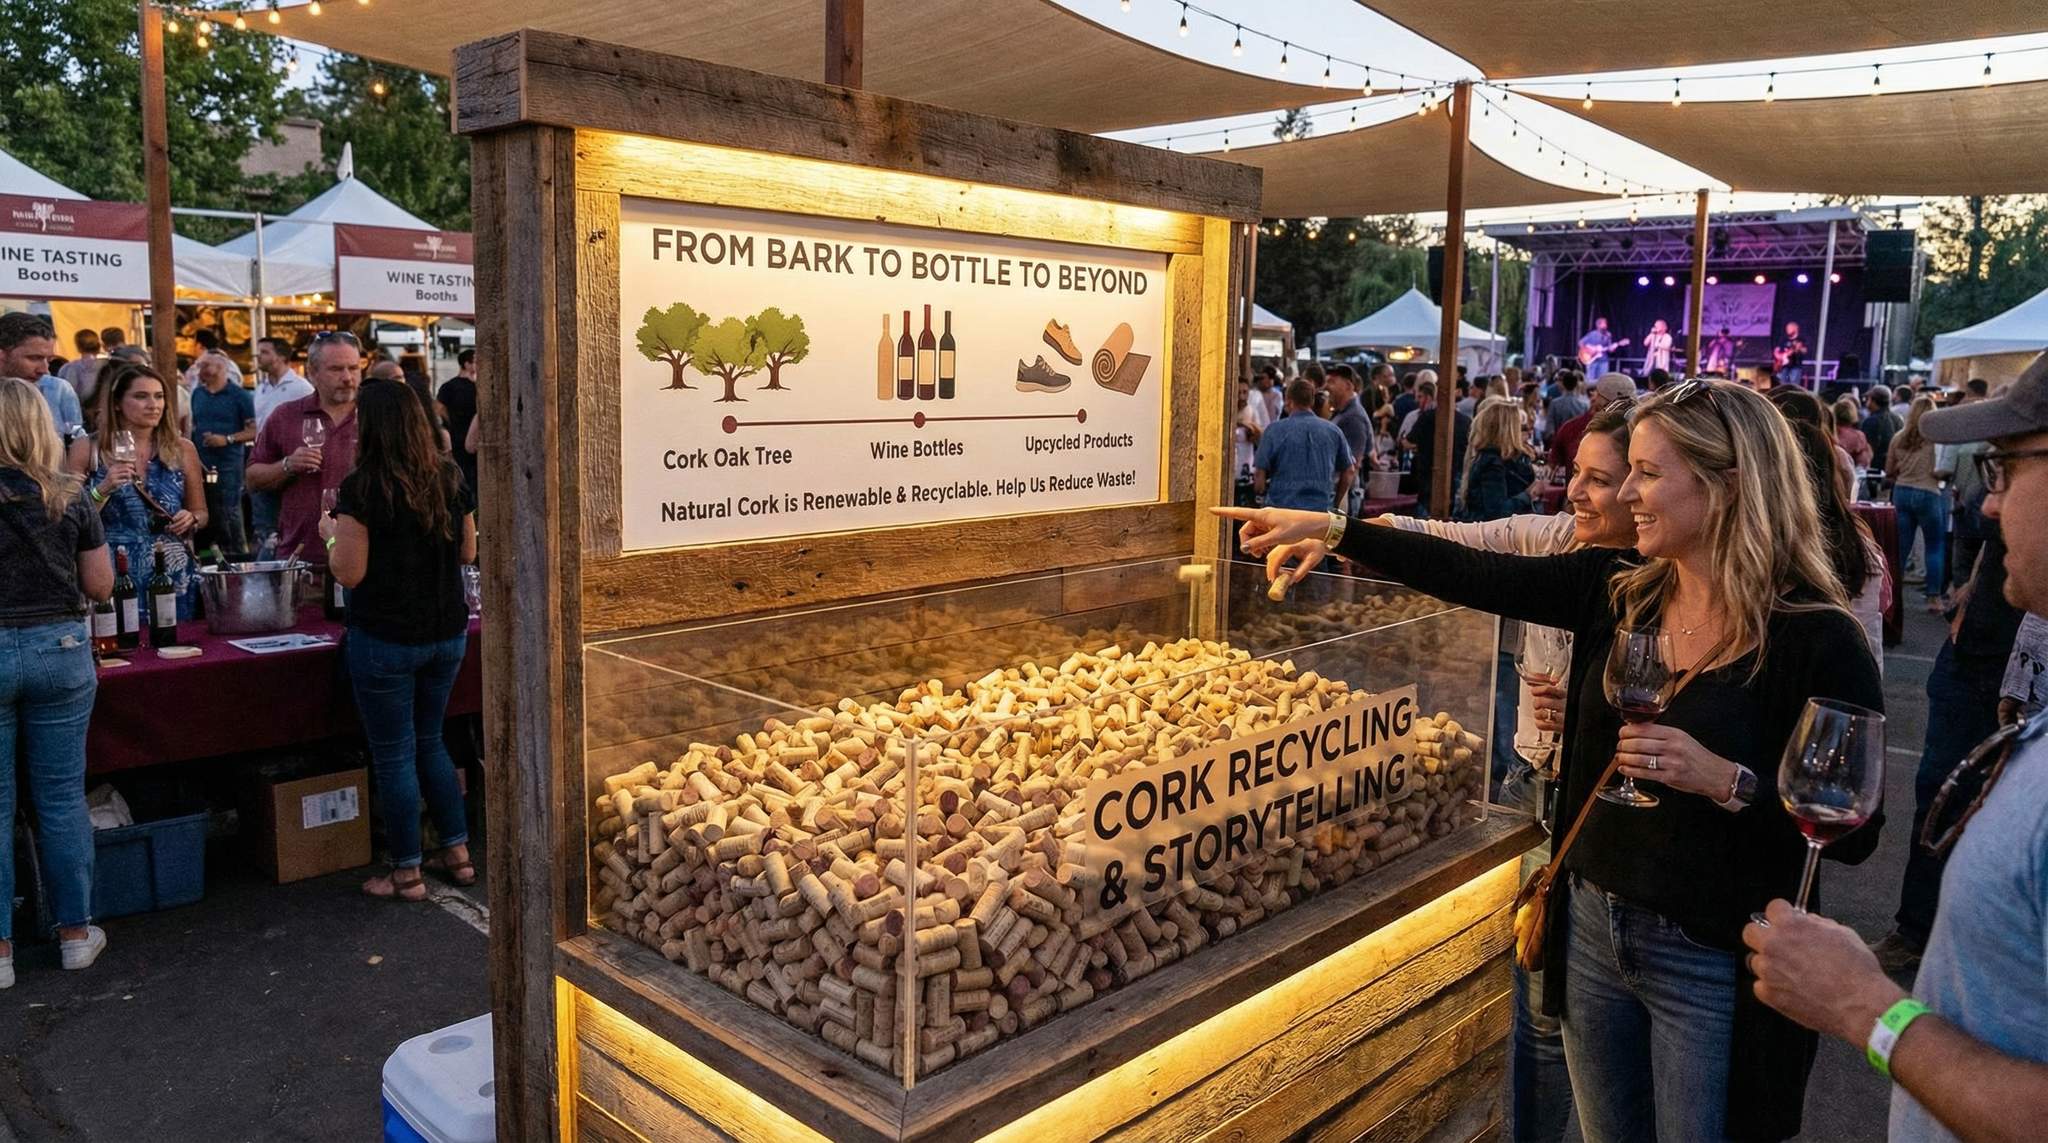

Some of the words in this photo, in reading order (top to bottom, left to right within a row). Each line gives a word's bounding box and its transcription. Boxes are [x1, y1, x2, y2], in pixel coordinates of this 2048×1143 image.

[1, 246, 35, 262] INE
[41, 248, 122, 267] TASTING
[652, 227, 755, 267] FROM
[767, 237, 855, 275] BARK
[863, 246, 902, 278] TO
[911, 251, 1011, 286] BOTTLE
[1019, 261, 1051, 289] TO
[1058, 264, 1148, 296] BEYOND
[18, 267, 79, 283] Booths
[386, 271, 425, 285] WINE
[428, 273, 475, 287] TASTIN
[415, 289, 459, 302] Booths
[870, 440, 909, 460] Wine
[913, 438, 964, 458] Bottles
[1025, 433, 1081, 455] Upcycled
[1083, 432, 1134, 449] Products
[663, 448, 708, 470] Cork
[713, 446, 750, 468] Oak
[755, 446, 793, 465] Tree
[661, 497, 732, 523] Natural
[737, 494, 780, 516] Cork
[785, 493, 798, 513] is
[803, 486, 892, 511] Renewable
[896, 485, 907, 504] &
[911, 480, 992, 504] Recyclable.
[996, 477, 1027, 498] Help
[1029, 477, 1046, 494] Us
[1049, 473, 1094, 492] Reduce
[1096, 469, 1137, 488] Waste!
[1092, 758, 1216, 841] CORK
[1228, 695, 1413, 798] RECYCLING
[1101, 859, 1128, 910] &
[1143, 753, 1406, 893] STORYTELLING
